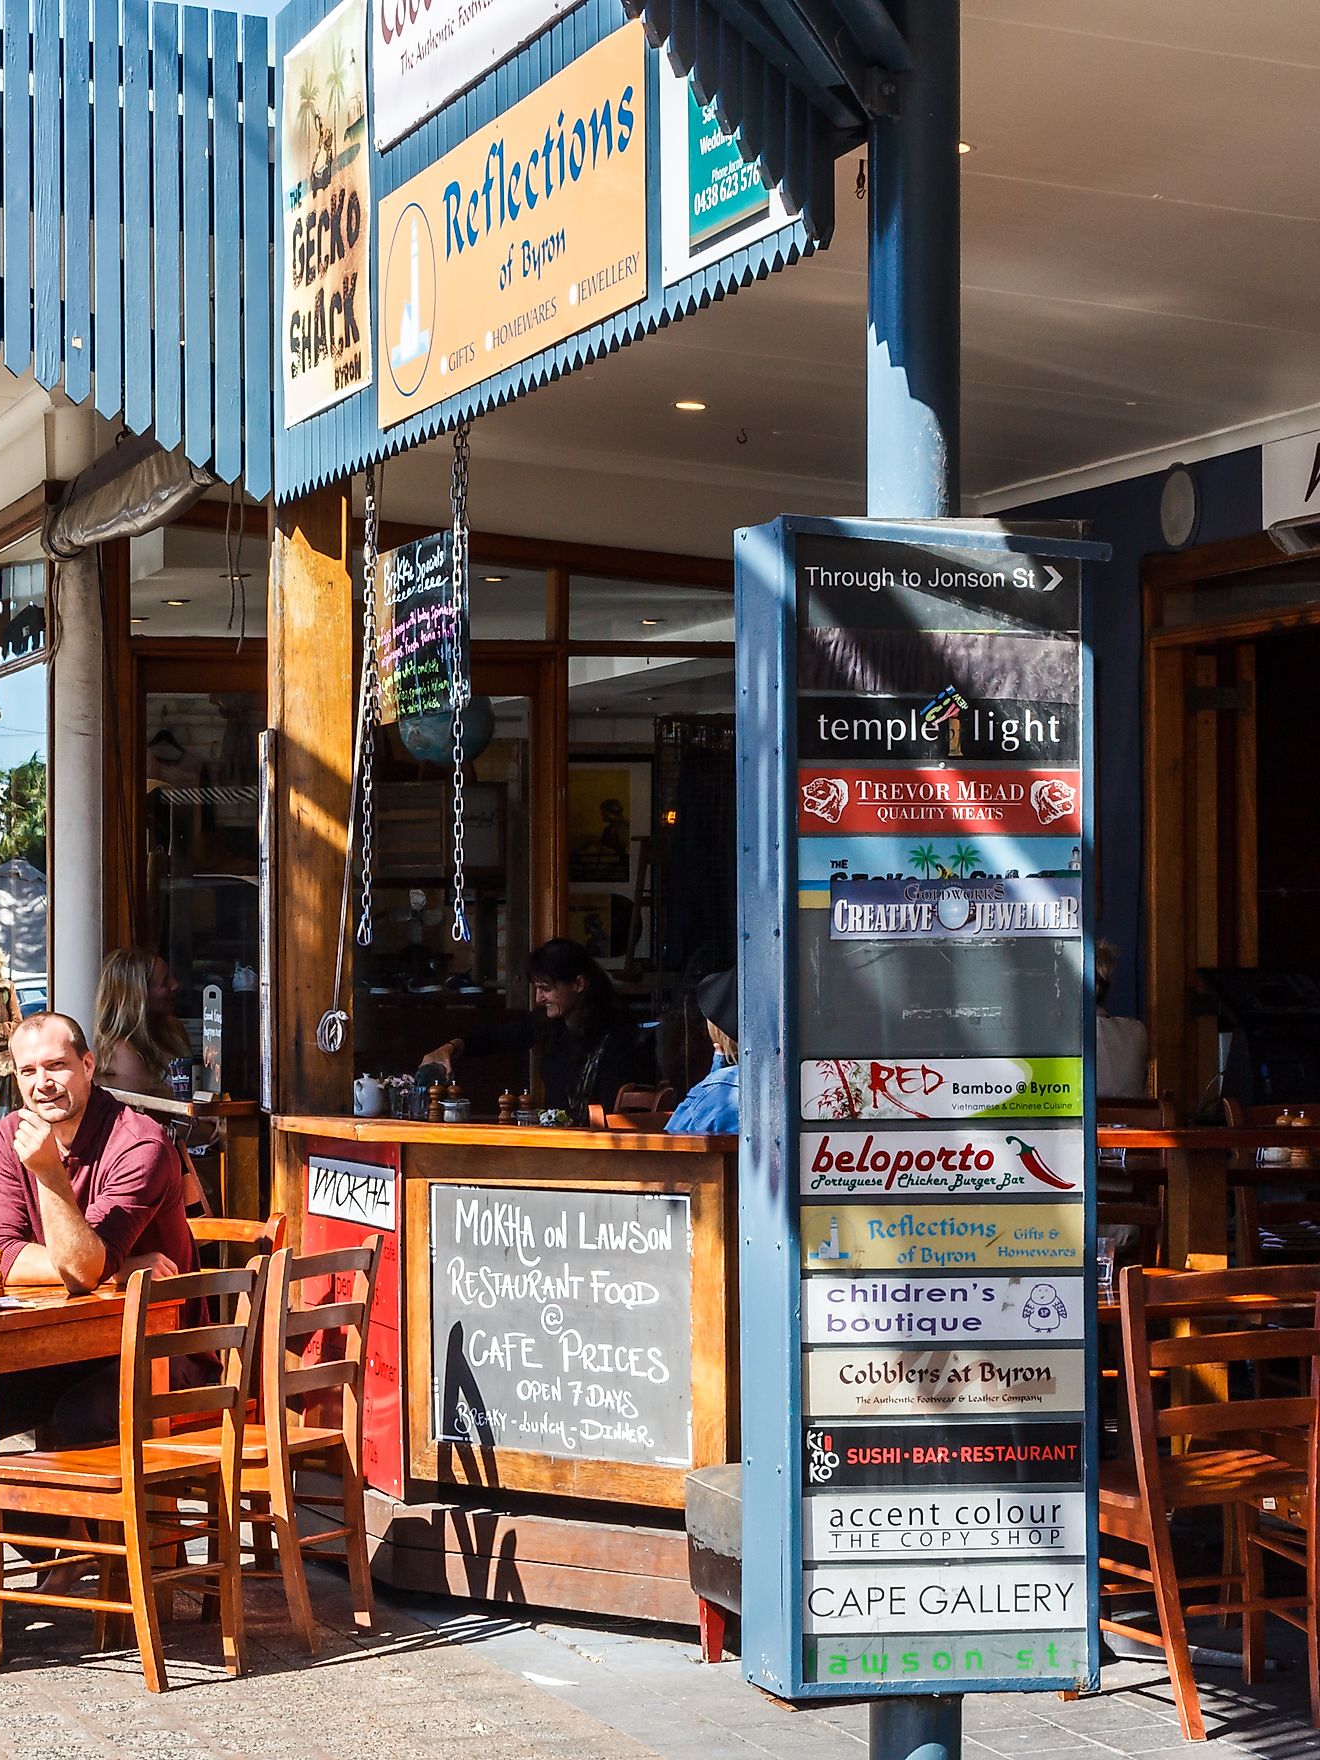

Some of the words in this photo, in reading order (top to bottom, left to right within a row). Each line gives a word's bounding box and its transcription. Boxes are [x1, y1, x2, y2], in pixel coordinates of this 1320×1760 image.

[401, 49, 414, 76] The
[416, 18, 455, 65] Authentic
[442, 86, 633, 262] Reflections
[694, 183, 718, 216] 0438
[719, 176, 739, 202] 623
[741, 163, 760, 192] 576
[711, 164, 728, 184] Phone
[290, 182, 302, 212] THE
[293, 188, 360, 290] GECKO
[499, 252, 514, 292] of
[521, 228, 566, 282] Byron
[577, 252, 641, 307] JEWELLERY
[290, 272, 360, 379] SHACK
[492, 298, 558, 350] HOMEWARES
[335, 351, 361, 390] BYRON
[448, 342, 476, 374] GIFTS
[805, 567, 894, 592] Through
[902, 569, 921, 587] to
[928, 568, 1005, 588] Jonson
[1012, 568, 1035, 588] St
[818, 709, 939, 750] temple
[974, 709, 1060, 751] light
[855, 780, 950, 801] TREVOR
[957, 780, 1025, 801] MEAD
[877, 807, 947, 822] QUALITY
[952, 807, 1003, 820] MEATS
[831, 859, 848, 869] THE
[904, 882, 1005, 902] GOLDWORKS
[834, 899, 934, 933] CREATIVE
[973, 896, 1079, 934] JEWELLER
[868, 1062, 948, 1118] RED
[952, 1081, 1012, 1095] Bamboo
[1016, 1081, 1026, 1095] @
[1030, 1082, 1070, 1098] Byron
[951, 1102, 1000, 1111] Vietnamese
[1001, 1102, 1008, 1110] &
[1009, 1102, 1042, 1110] Chinese
[1043, 1101, 1072, 1110] Cuisine
[811, 1135, 995, 1190] beloporto
[313, 1167, 390, 1220] MOKHA
[811, 1175, 883, 1190] Portuguese
[897, 1173, 949, 1187] Chicken
[948, 1174, 997, 1191] Burger
[995, 1173, 1025, 1190] Bar
[455, 1199, 541, 1267] MOKHA
[579, 1212, 672, 1254] LAWSON
[867, 1214, 997, 1240] Reflections
[1013, 1227, 1044, 1241] Gifts
[1048, 1229, 1060, 1240] &
[897, 1246, 915, 1265] of
[920, 1247, 977, 1267] Byron
[998, 1245, 1076, 1258] Homewares
[447, 1256, 584, 1308] RESTAURANT
[590, 1269, 660, 1311] FOOD
[827, 1283, 995, 1303] children's
[541, 1303, 564, 1335] @
[827, 1312, 982, 1336] boutique
[468, 1329, 543, 1372] CAFE
[559, 1328, 670, 1384] PRICES
[839, 1362, 940, 1386] Cobblers
[947, 1363, 972, 1382] at
[980, 1362, 1052, 1388] Byron
[516, 1376, 561, 1403] OPEN
[568, 1381, 582, 1406] 7
[585, 1384, 639, 1419] DAYS
[856, 1396, 871, 1404] The
[873, 1395, 914, 1404] Authentic
[917, 1395, 955, 1404] Footwear
[958, 1395, 965, 1403] &
[968, 1394, 1000, 1403] Leather
[1002, 1393, 1042, 1405] Company
[580, 1418, 654, 1448] DINNER
[830, 1503, 940, 1527] accent
[955, 1498, 1062, 1525] colour
[831, 1532, 881, 1549] THE
[900, 1531, 970, 1547] COPY
[991, 1529, 1061, 1546] SHOP
[808, 1586, 906, 1617] CAPE
[919, 1582, 1074, 1614] GALLERY
[807, 1648, 983, 1676] lawson
